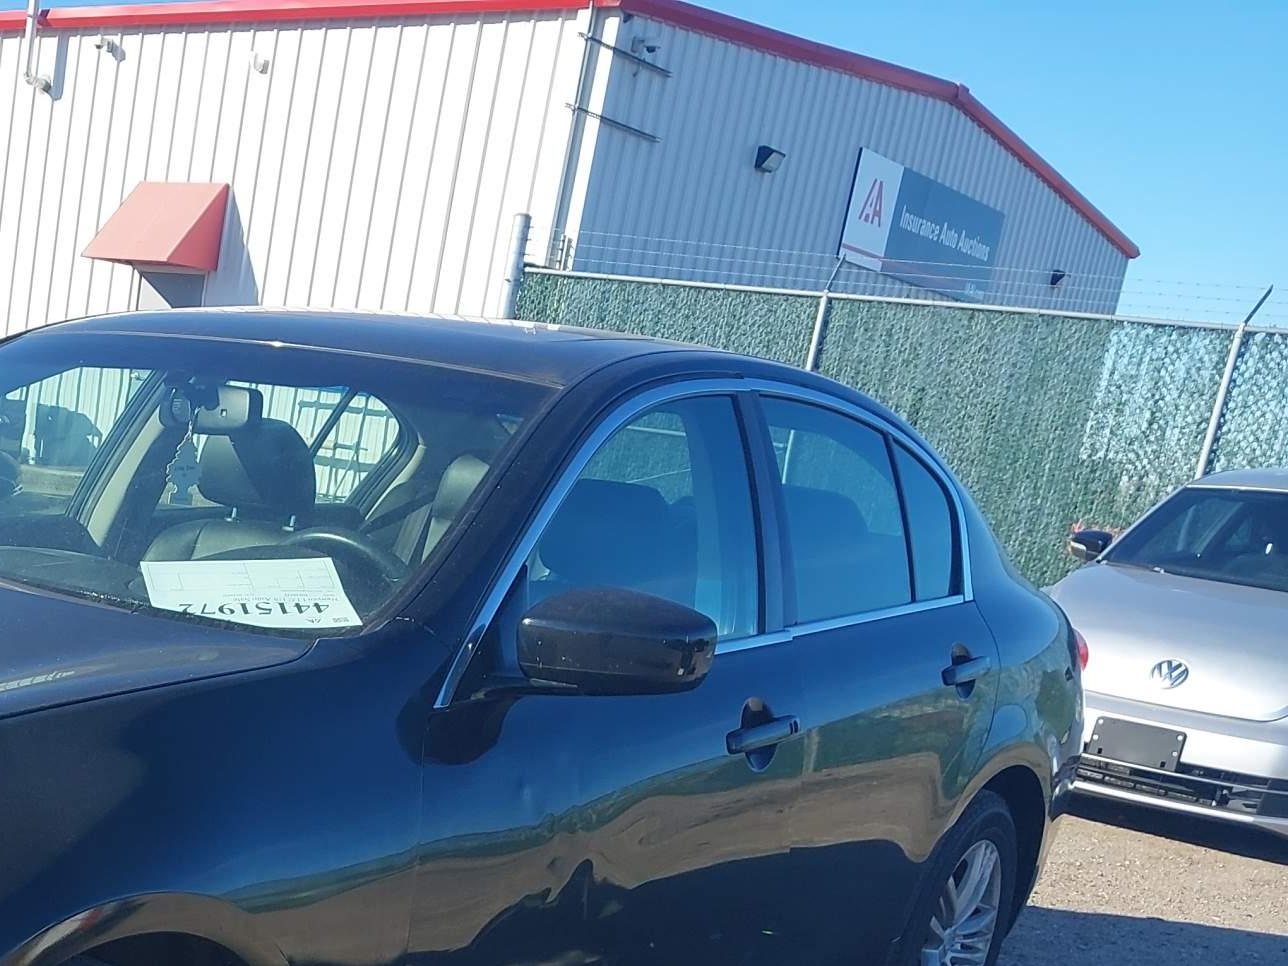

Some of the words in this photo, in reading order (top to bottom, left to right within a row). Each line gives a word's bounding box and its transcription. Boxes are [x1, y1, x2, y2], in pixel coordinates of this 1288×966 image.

[900, 204, 939, 240] Insurance
[939, 222, 958, 249] Auto
[958, 229, 990, 262] Auctions
[178, 602, 330, 616] 44151972
